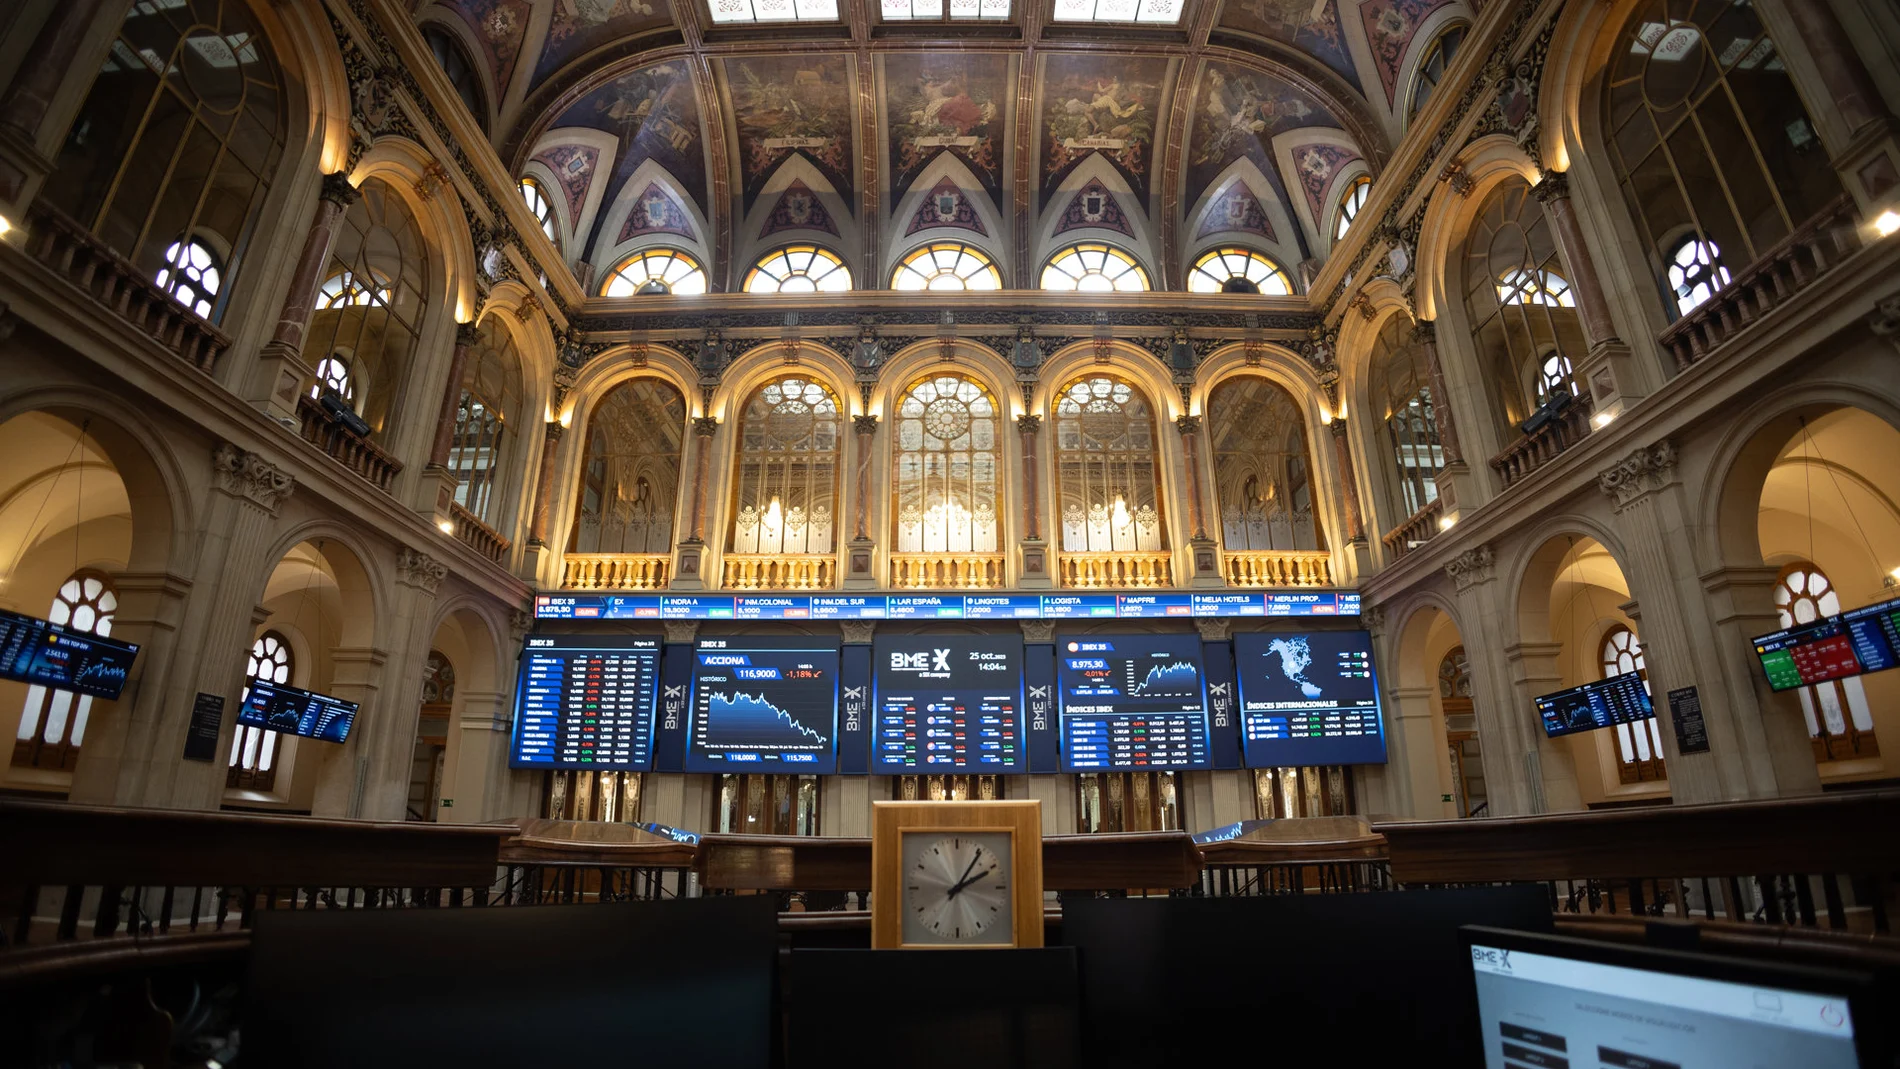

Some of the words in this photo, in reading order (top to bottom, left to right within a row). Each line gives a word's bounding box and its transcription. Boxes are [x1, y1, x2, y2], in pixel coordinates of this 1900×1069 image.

[850, 598, 865, 606] SUR
[912, 596, 941, 605] ESPAÑA
[704, 656, 744, 665] ACCIONA
[890, 652, 929, 668] BME
[970, 652, 980, 660] 25
[1072, 660, 1104, 668] 8.975,30
[739, 670, 776, 679] 116,9000
[786, 670, 812, 679] -1,18%
[1084, 670, 1104, 678] -0,01%
[1066, 705, 1095, 713] ÍNDICES
[1247, 701, 1274, 710] ÍNDICES
[1276, 700, 1338, 709] INTERNACIONALES
[664, 701, 676, 730] BME
[846, 702, 858, 732] BME
[1032, 702, 1044, 730] BME
[1215, 698, 1227, 727] BME
[1472, 948, 1497, 963] BME
